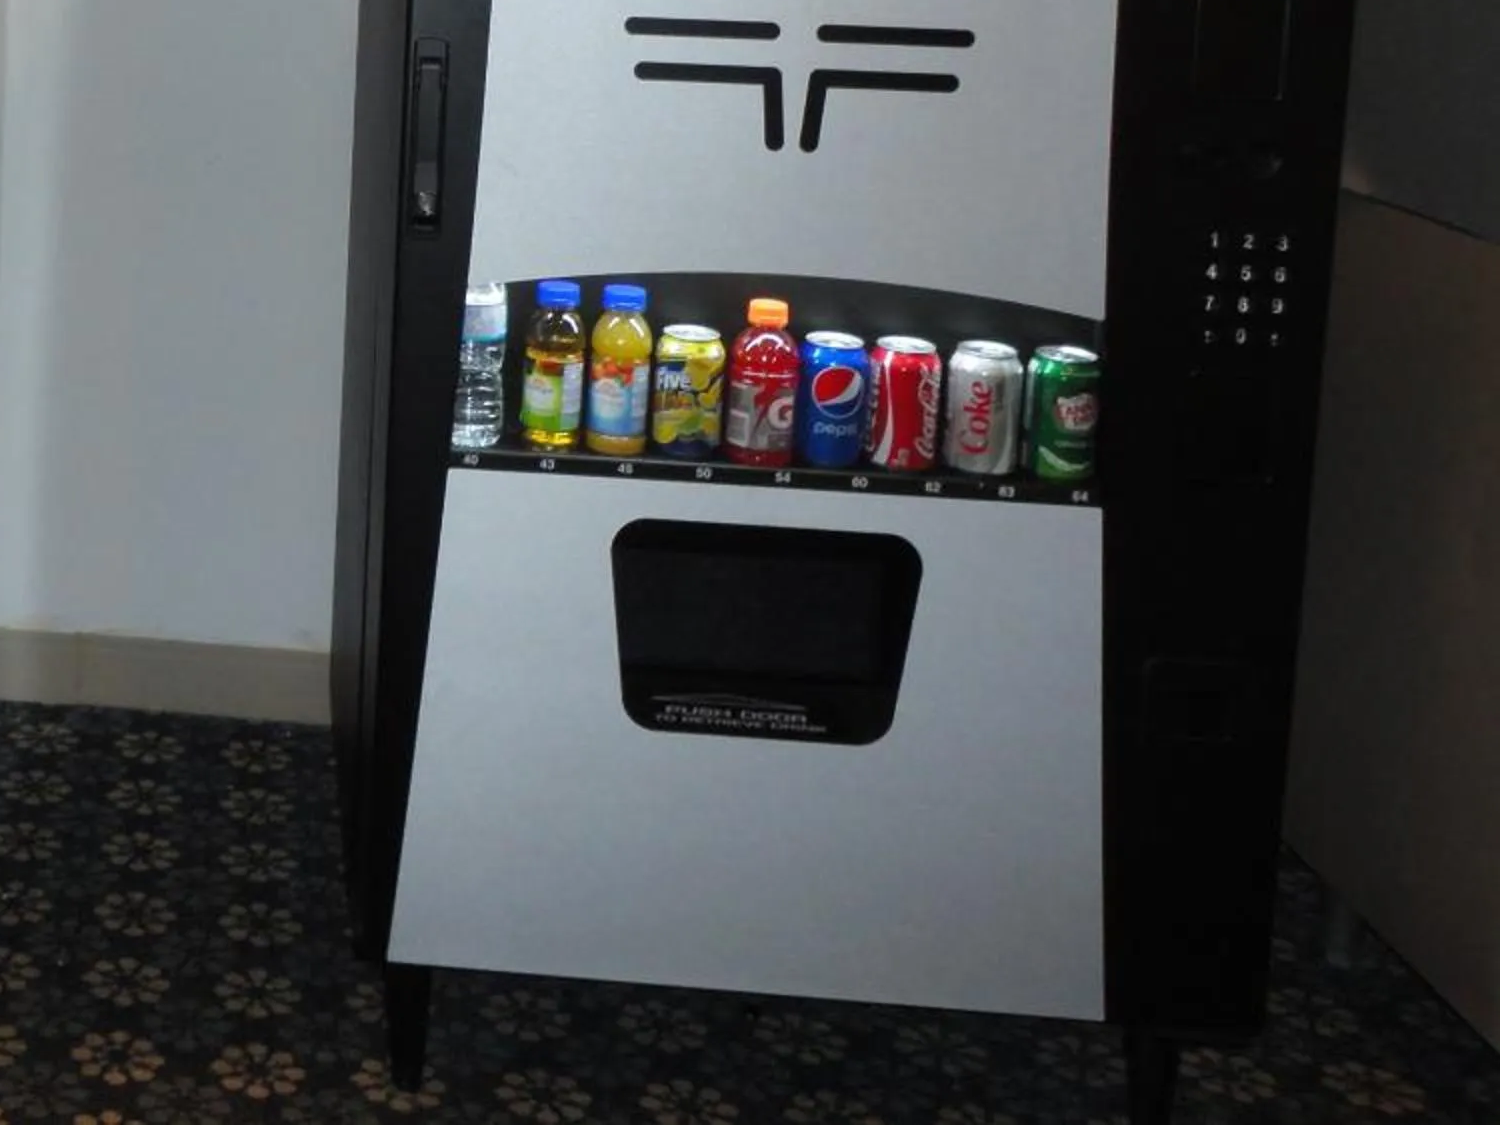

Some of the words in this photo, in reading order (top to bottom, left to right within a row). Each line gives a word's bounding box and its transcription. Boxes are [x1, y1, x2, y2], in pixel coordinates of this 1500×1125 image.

[1210, 231, 1219, 248] 1
[1243, 234, 1255, 249] 2
[1276, 235, 1289, 251] 3
[1206, 263, 1217, 280] 4
[1241, 265, 1252, 282] 5
[1274, 266, 1286, 283] 6
[1205, 295, 1215, 311] 7
[1237, 296, 1249, 313] 8
[1272, 298, 1284, 314] 9
[1236, 328, 1247, 344] 0
[960, 380, 993, 455] Coke
